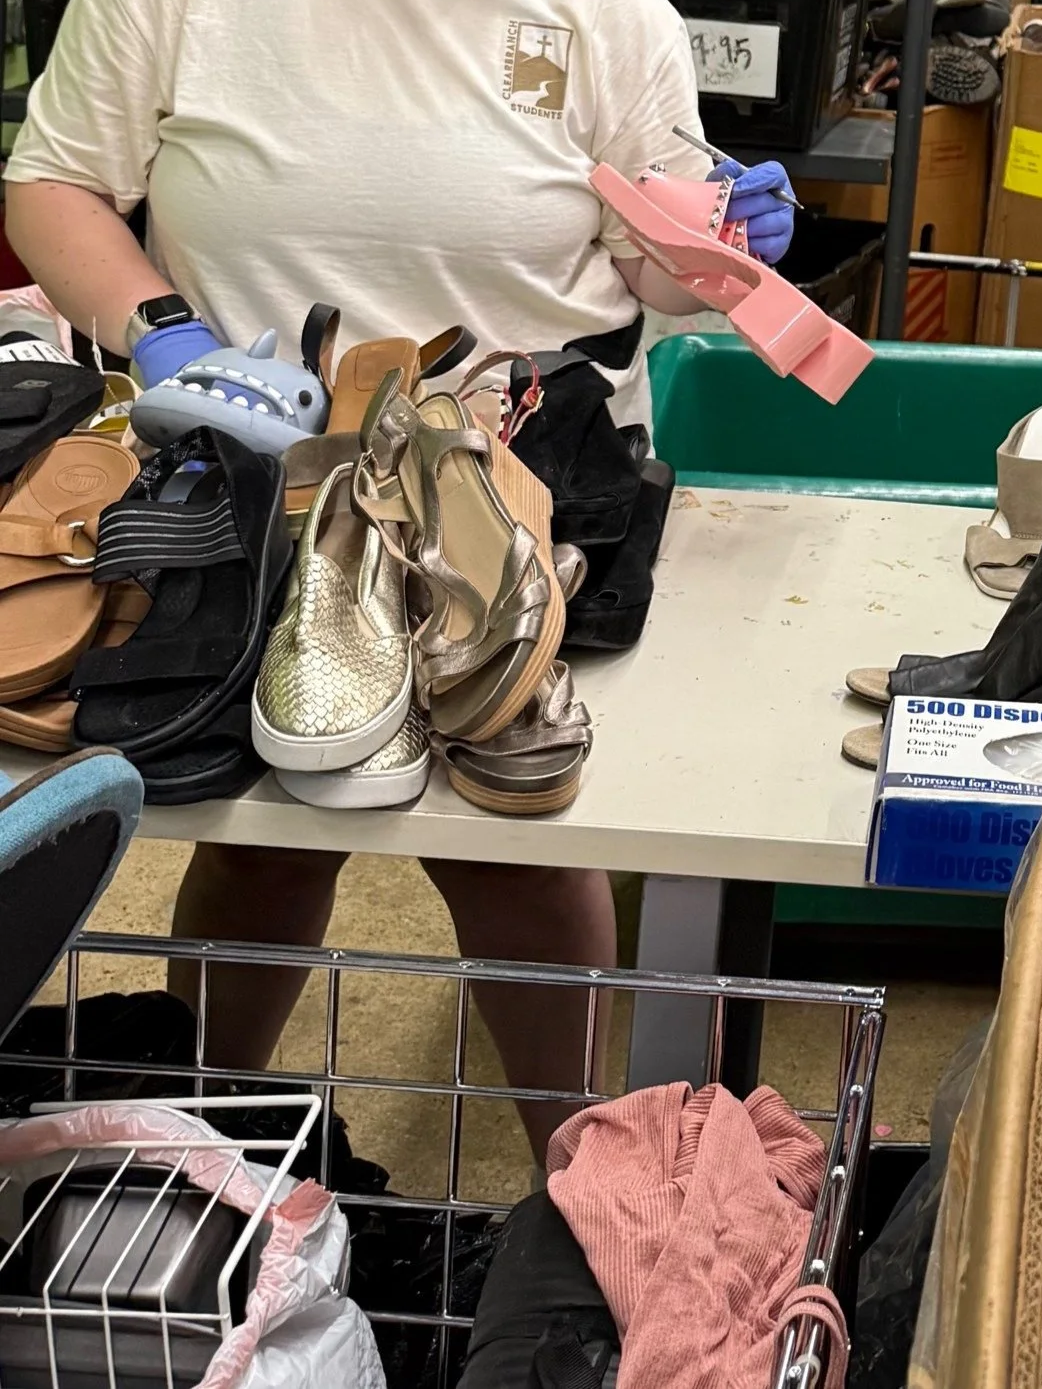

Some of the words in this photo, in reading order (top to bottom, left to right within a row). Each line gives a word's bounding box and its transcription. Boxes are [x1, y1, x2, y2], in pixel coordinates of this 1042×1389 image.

[502, 19, 518, 101] CLEARBRANCH
[510, 103, 564, 121] STUDENTS
[906, 699, 966, 717] 500
[908, 726, 977, 738] Polyethylene
[909, 718, 985, 732] High-Density
[906, 738, 932, 746] One
[933, 740, 957, 749] Size
[906, 747, 928, 755] Fits
[930, 749, 948, 757] All
[901, 773, 966, 789] Approved
[968, 777, 988, 789] for
[990, 779, 1023, 792] Food
[979, 811, 1040, 847] Dis
